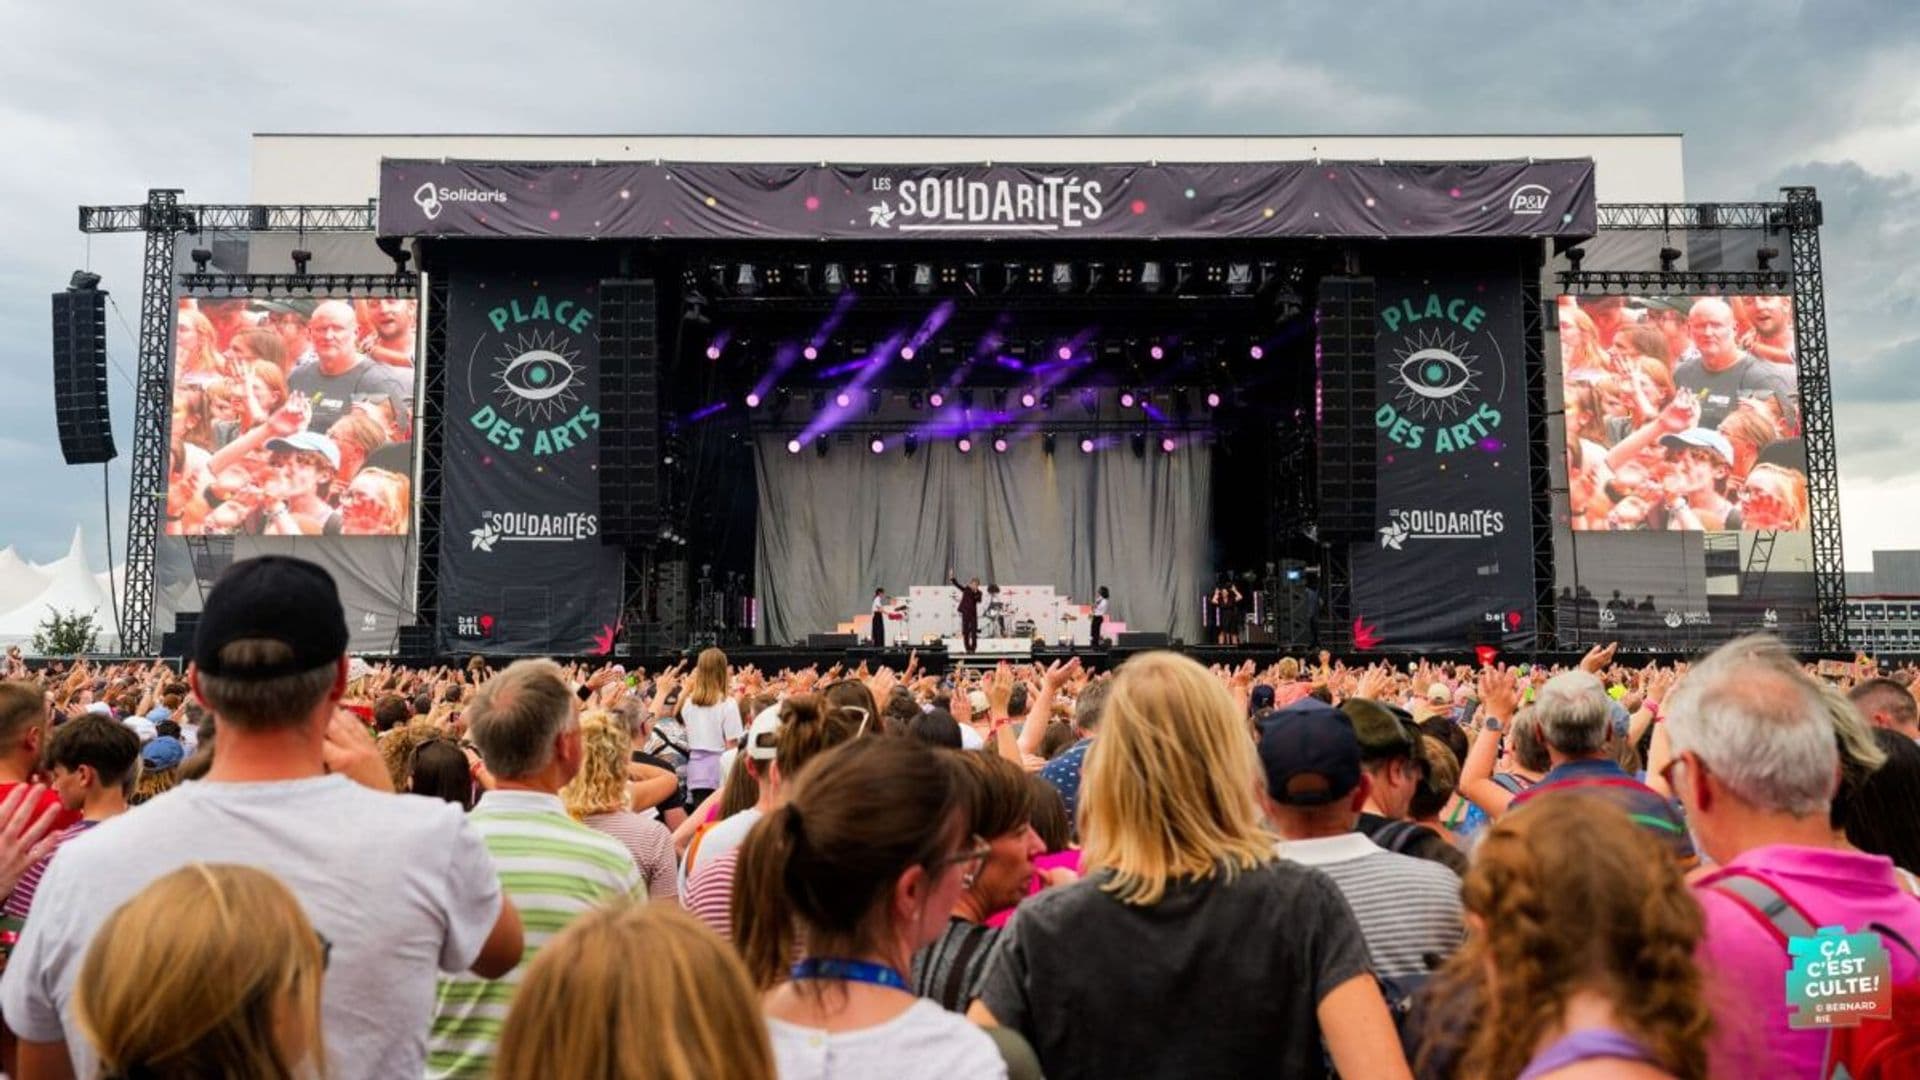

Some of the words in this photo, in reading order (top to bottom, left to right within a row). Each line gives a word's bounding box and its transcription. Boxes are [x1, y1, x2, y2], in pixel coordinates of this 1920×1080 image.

[439, 187, 507, 202] Solidaris
[873, 178, 891, 190] LES
[900, 177, 1102, 227] SOLIDARITÉS
[1515, 194, 1549, 209] P&V
[488, 296, 593, 333] PLACE
[1381, 294, 1486, 332] PLACE
[469, 405, 524, 451] DES
[533, 405, 600, 455] ARTS
[1376, 403, 1425, 449] DES
[1435, 402, 1501, 454] ARTS
[493, 512, 597, 539] SOLIDARITÉS
[1400, 510, 1503, 537] SOLIDARITÉS
[459, 624, 481, 635] RTL
